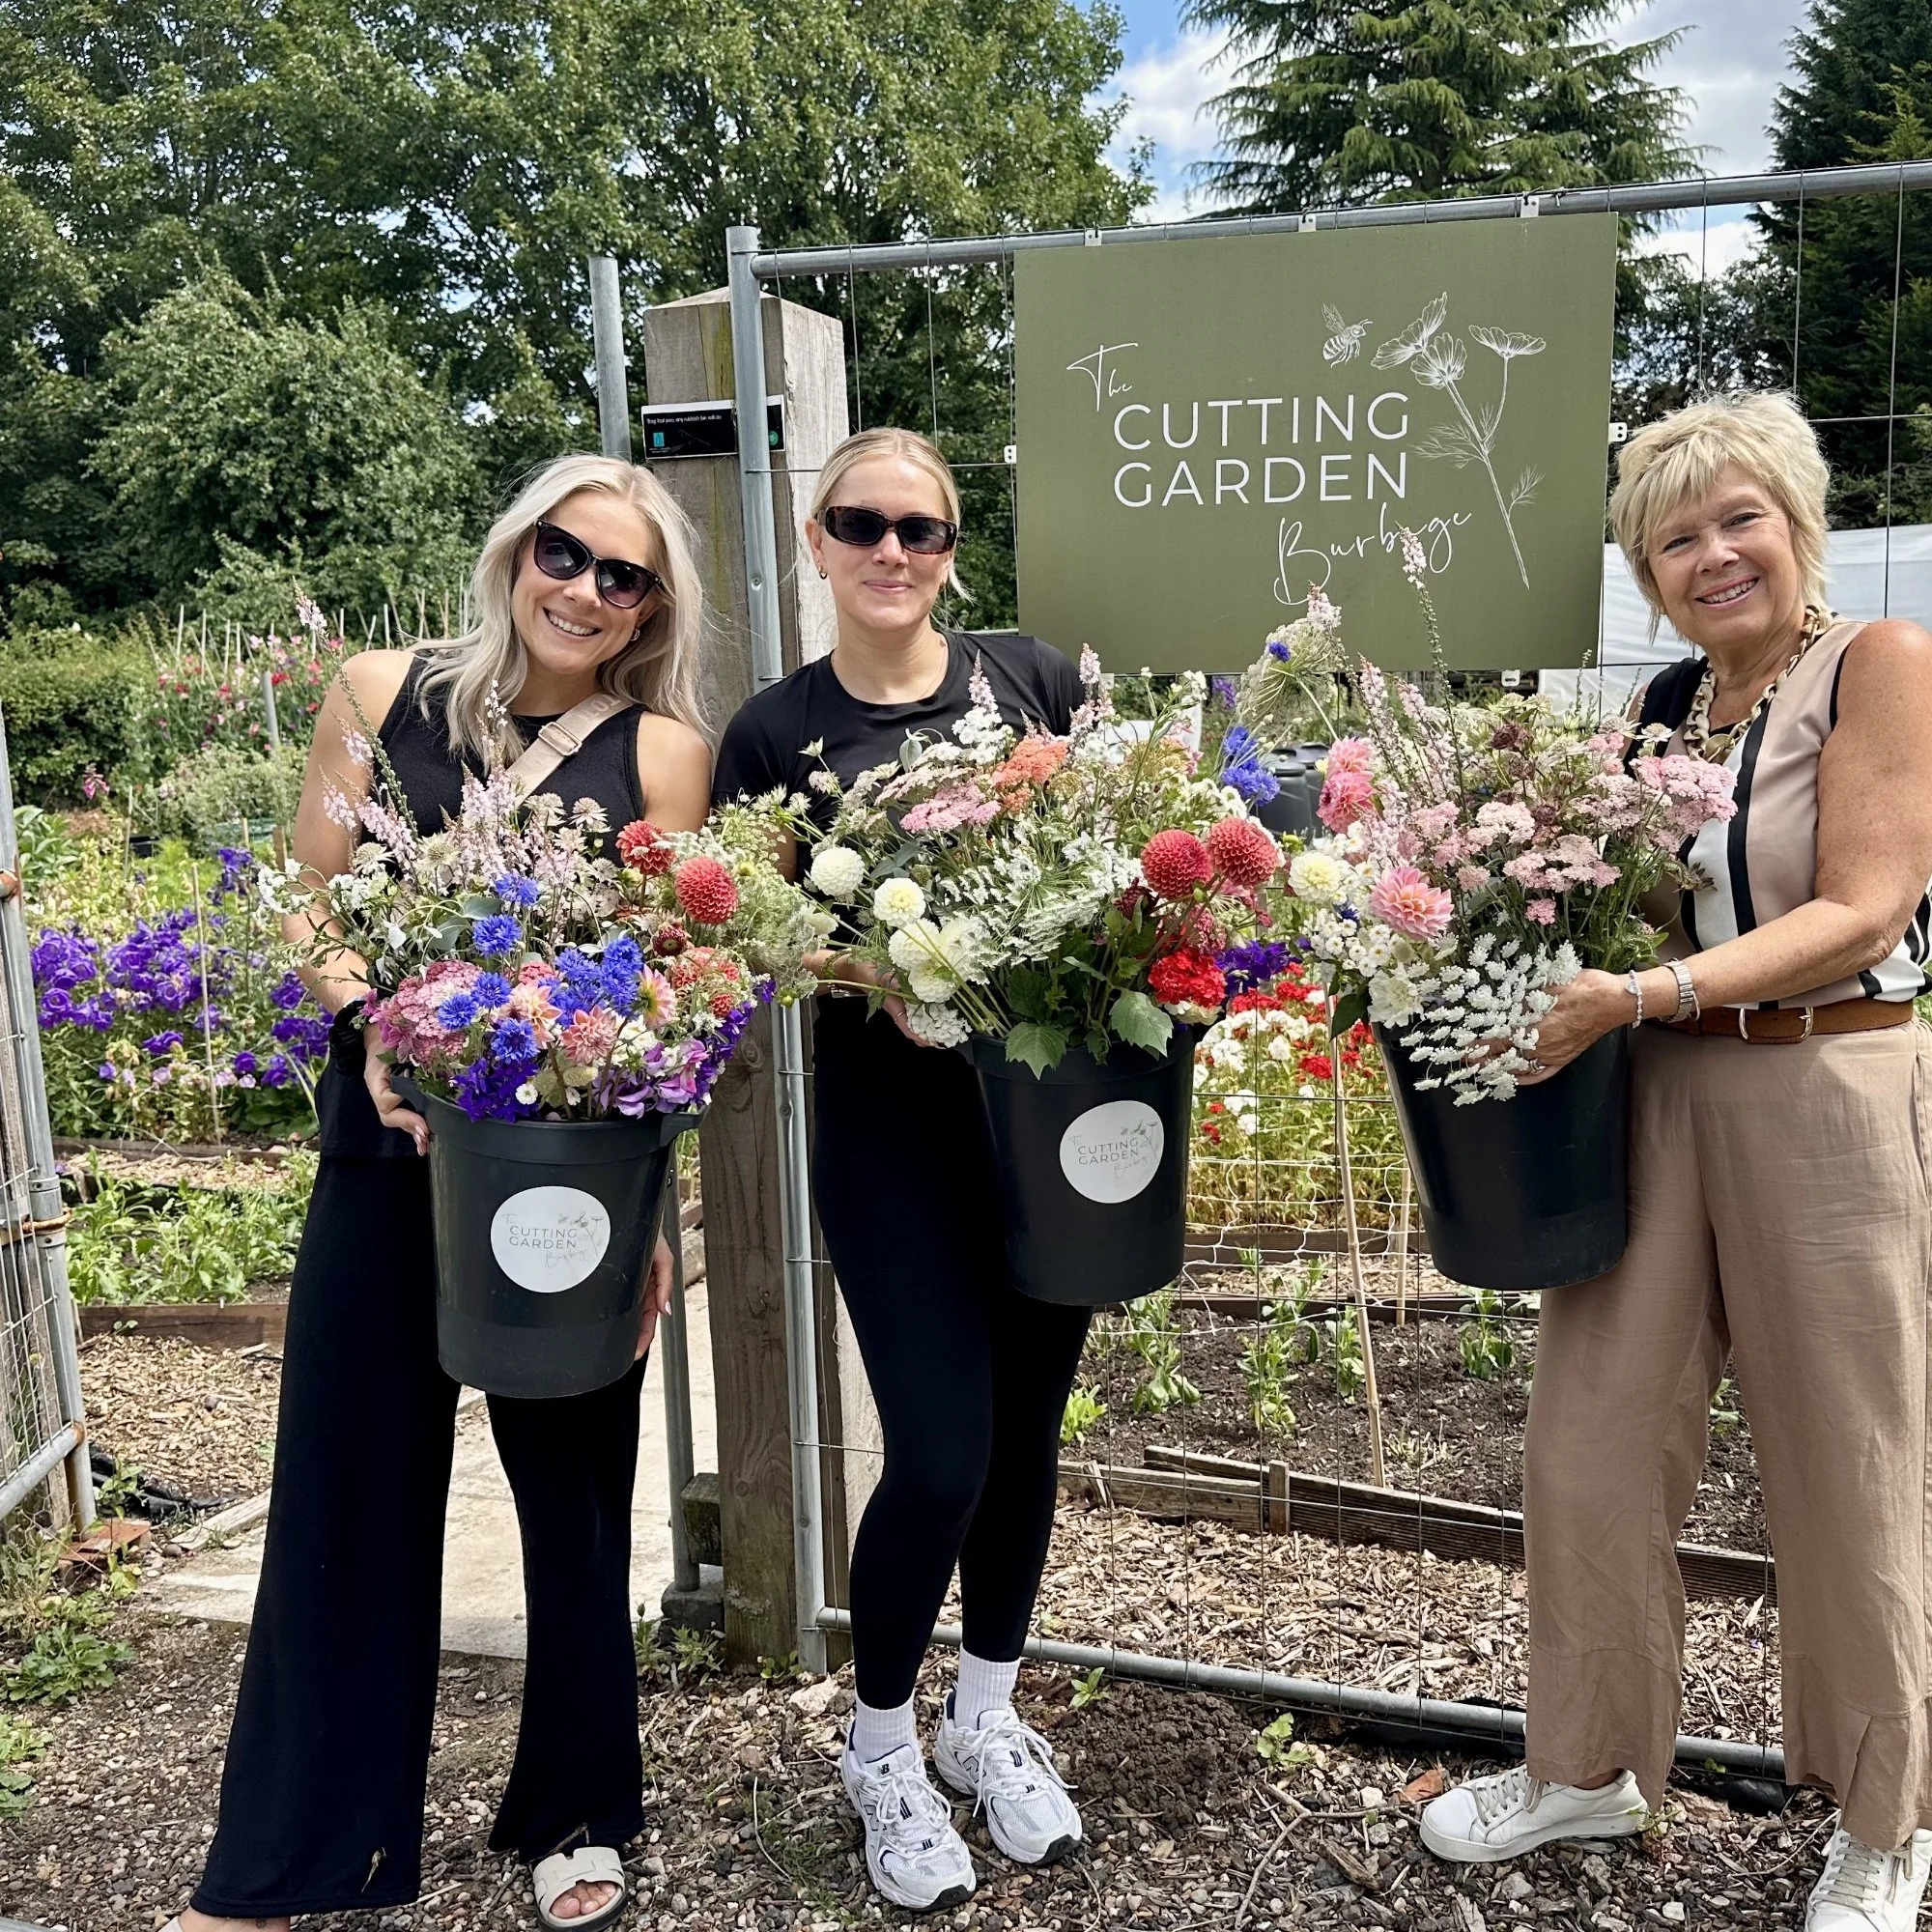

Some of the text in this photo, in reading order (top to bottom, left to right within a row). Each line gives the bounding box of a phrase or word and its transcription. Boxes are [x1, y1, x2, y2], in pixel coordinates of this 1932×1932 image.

[1065, 342, 1139, 412] The
[1113, 391, 1409, 451] CUTTING
[1113, 451, 1407, 508] GARDEN
[1273, 501, 1473, 606] Burbge
[1077, 1137, 1139, 1155] CUTTING
[1078, 1149, 1139, 1165] GARDEN
[509, 1225, 578, 1238] CUTTING
[509, 1236, 577, 1249] GARDEN
